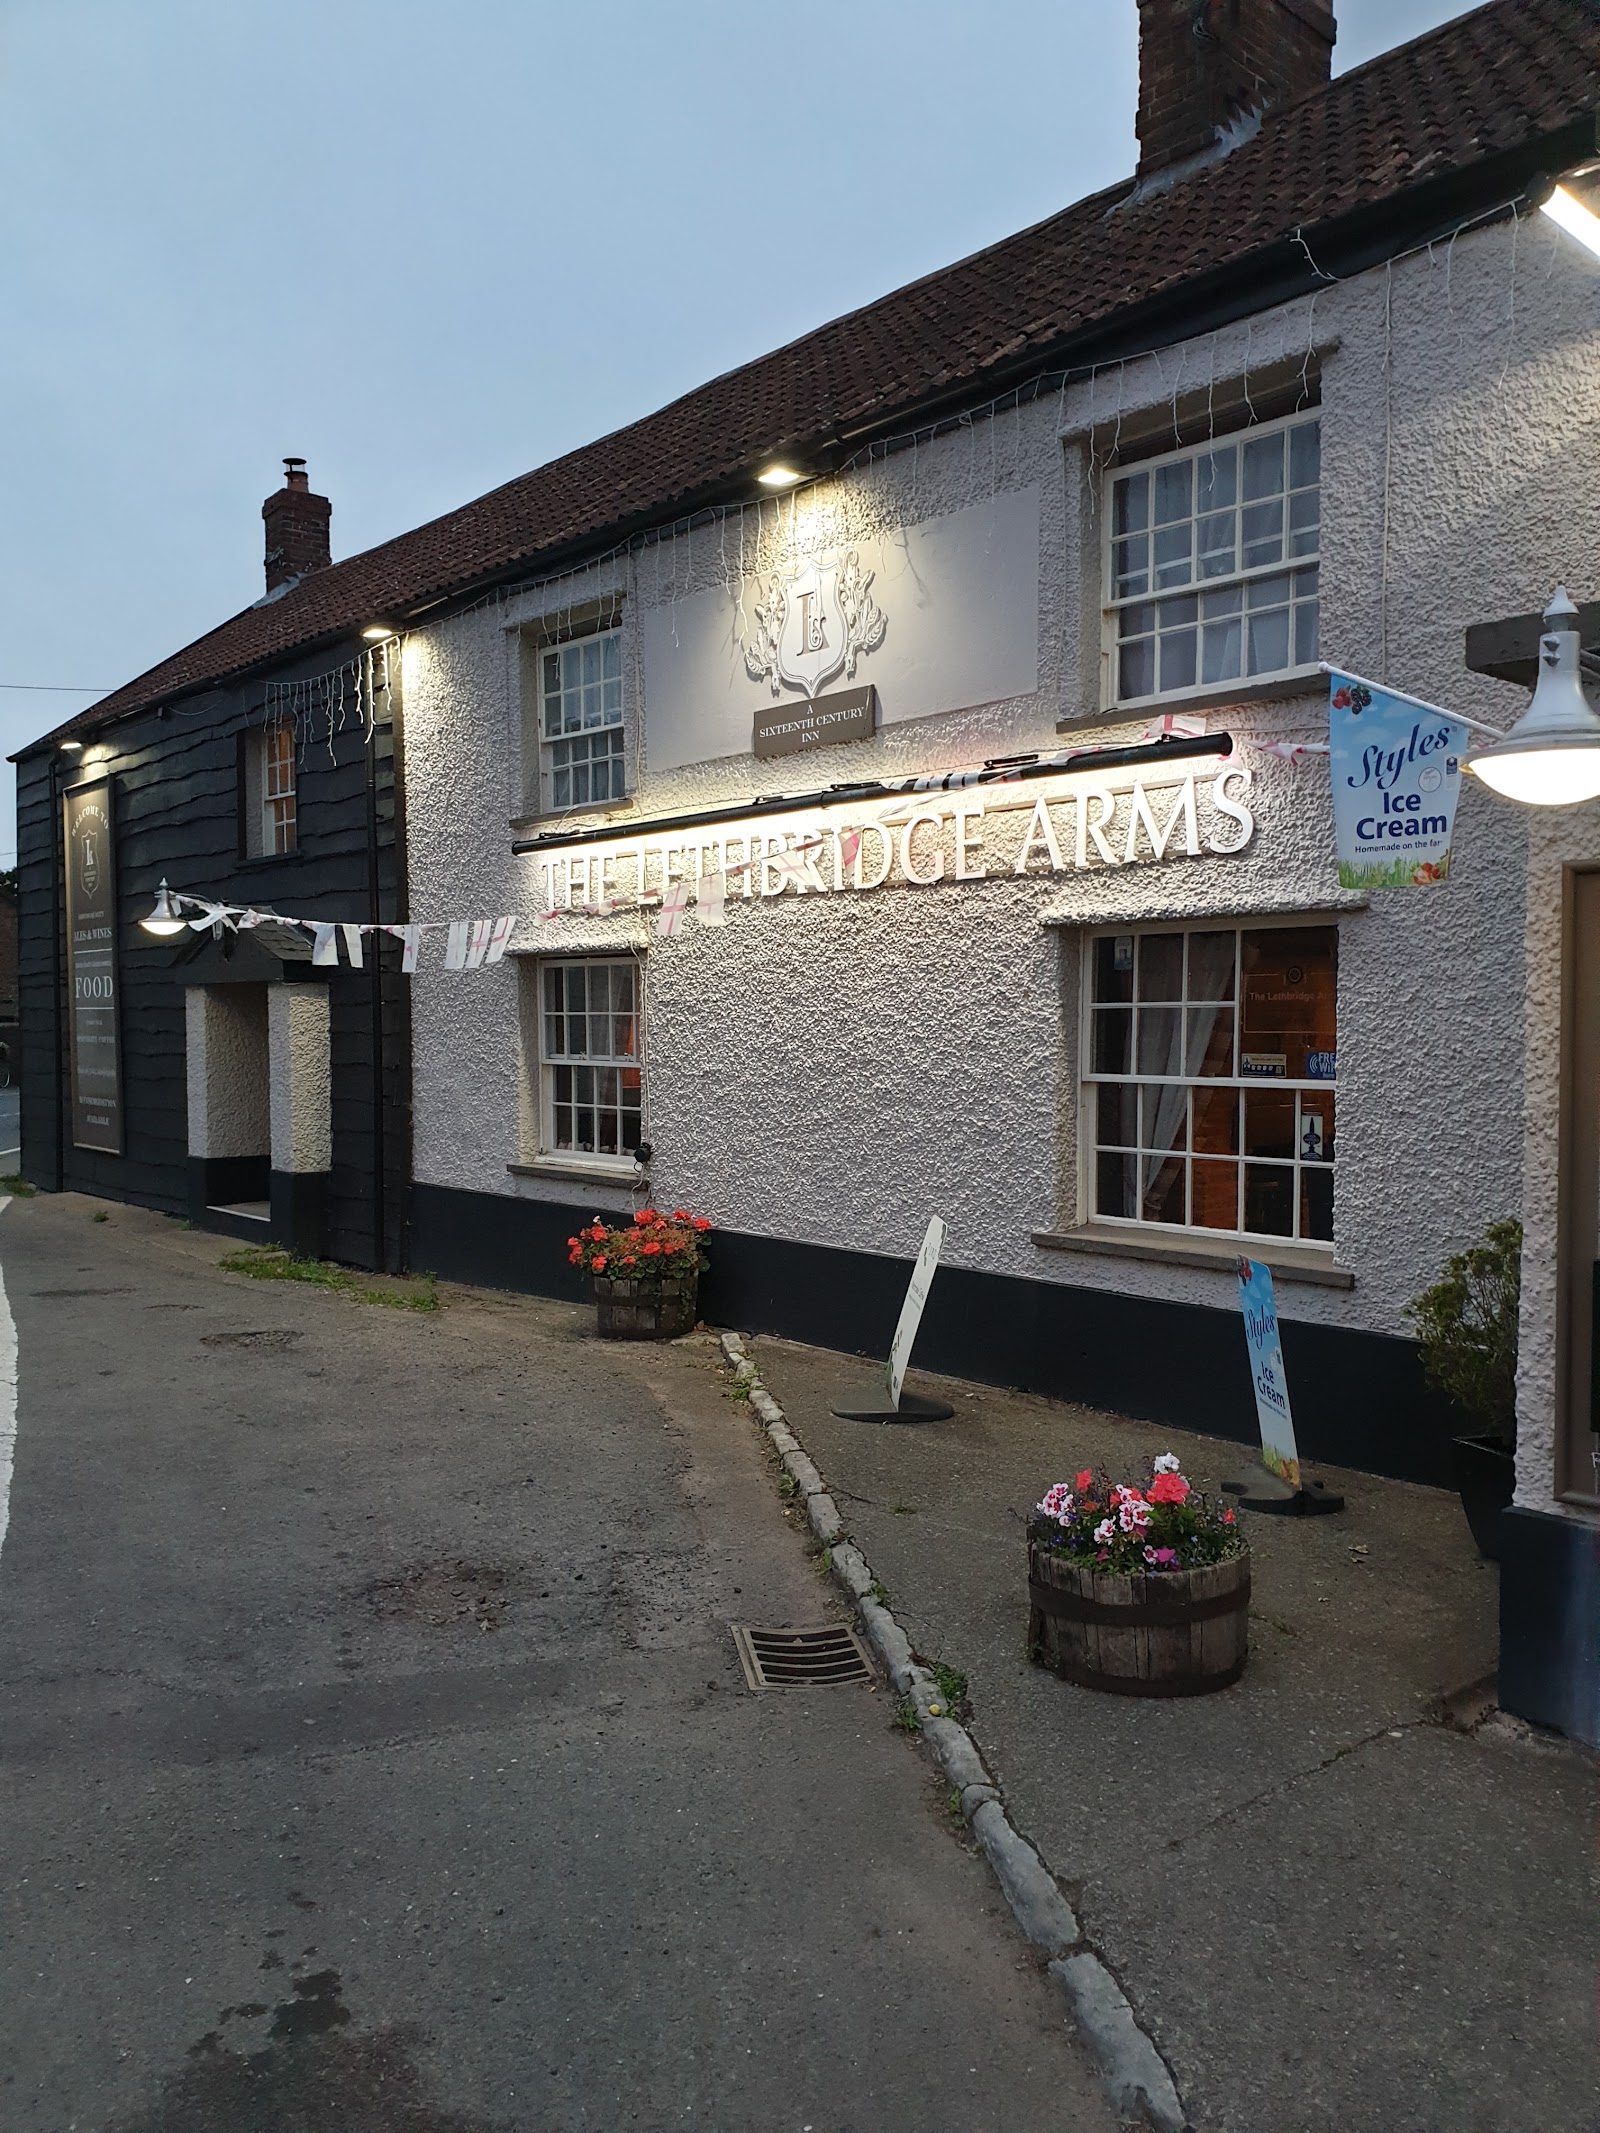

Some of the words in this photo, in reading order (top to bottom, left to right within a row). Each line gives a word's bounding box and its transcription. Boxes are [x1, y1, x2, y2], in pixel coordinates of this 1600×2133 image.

[806, 704, 814, 715] A
[759, 717, 815, 738] SIXTEENTH
[816, 707, 865, 726] CENTURY
[801, 731, 820, 743] INN
[1347, 723, 1450, 790] Styles
[1383, 792, 1422, 814] Ice
[71, 804, 100, 837] WELCOME
[100, 811, 109, 830] TO
[1356, 815, 1447, 840] Cream
[542, 852, 618, 912] THE
[636, 807, 986, 906] LETHBRIDGE
[1014, 768, 1255, 874] ARMS
[1354, 842, 1401, 853] Homemade
[1402, 841, 1413, 850] on
[1415, 840, 1428, 849] the
[92, 927, 113, 940] WINES
[75, 975, 114, 999] FOOD
[1318, 1051, 1335, 1063] FRE
[1246, 1303, 1275, 1350] Styles
[1260, 1360, 1275, 1385] Ice
[1257, 1375, 1286, 1410] Cream
